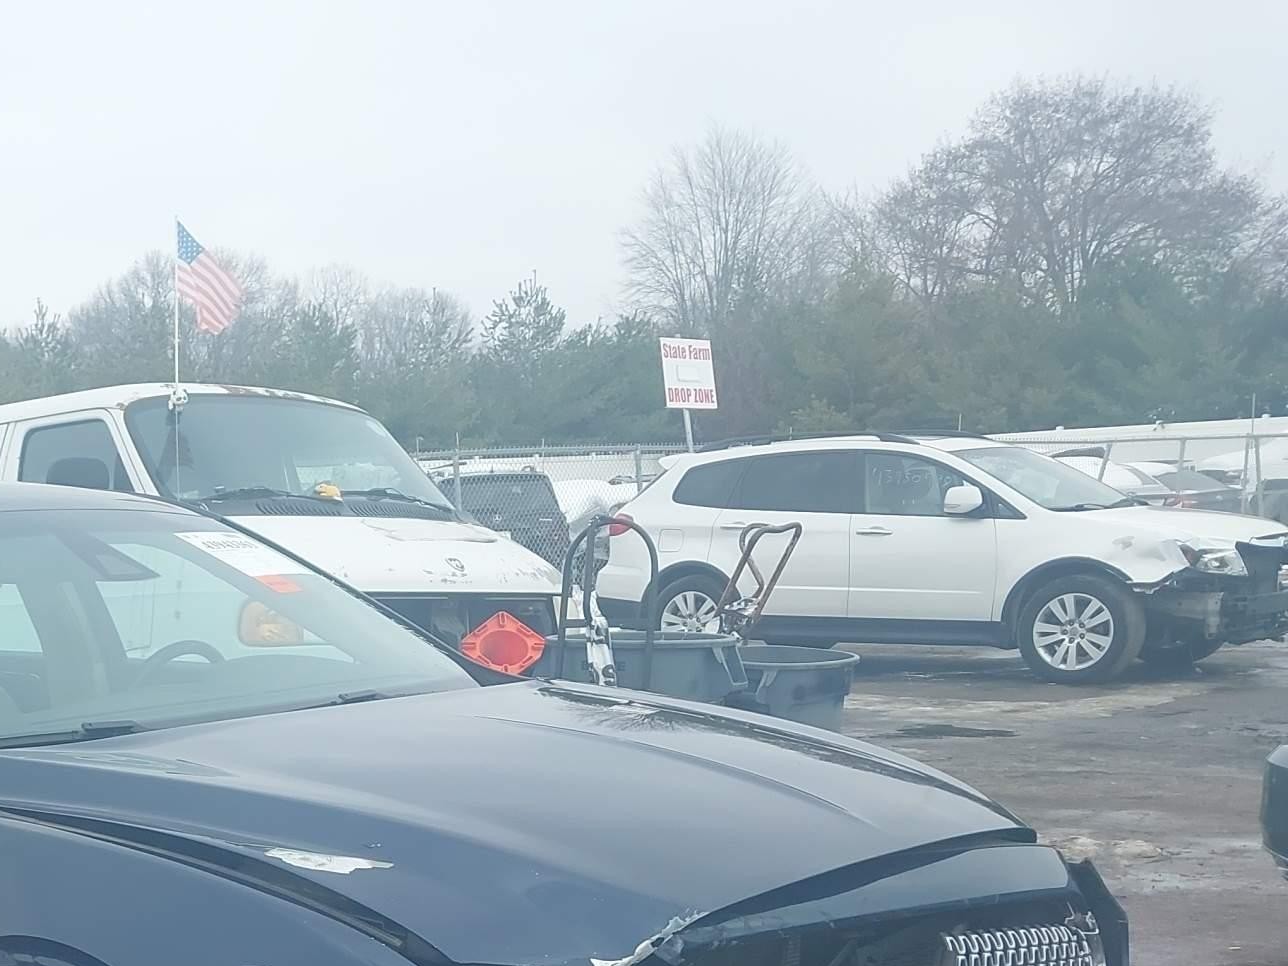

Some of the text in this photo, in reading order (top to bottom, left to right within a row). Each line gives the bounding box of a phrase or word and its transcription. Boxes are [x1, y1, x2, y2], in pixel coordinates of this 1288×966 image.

[662, 343, 711, 361] State Farm
[667, 387, 715, 404] DROP ZONE
